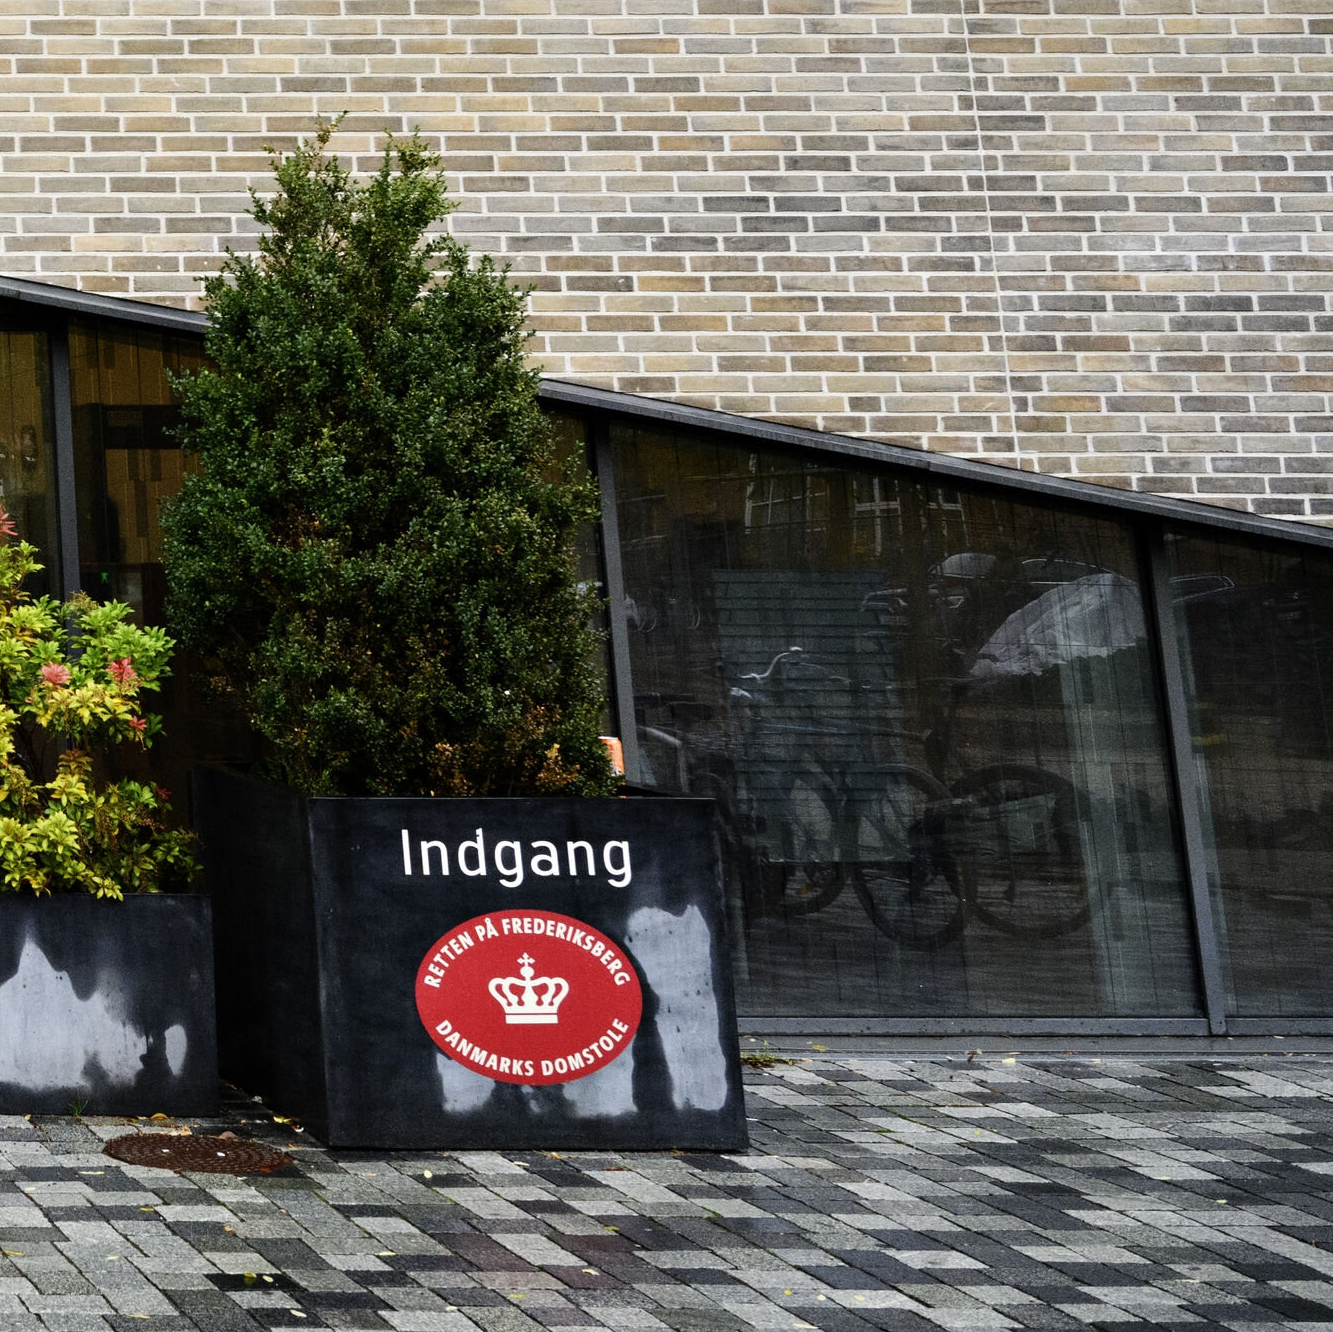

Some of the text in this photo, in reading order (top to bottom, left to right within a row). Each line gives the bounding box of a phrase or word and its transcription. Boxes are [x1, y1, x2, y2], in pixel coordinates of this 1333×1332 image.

[402, 828, 632, 888] Indgang
[423, 917, 630, 988] RETTEN PÅ FREDERIKSBERG
[435, 1018, 629, 1077] DANMARKS DOMSTOLE
